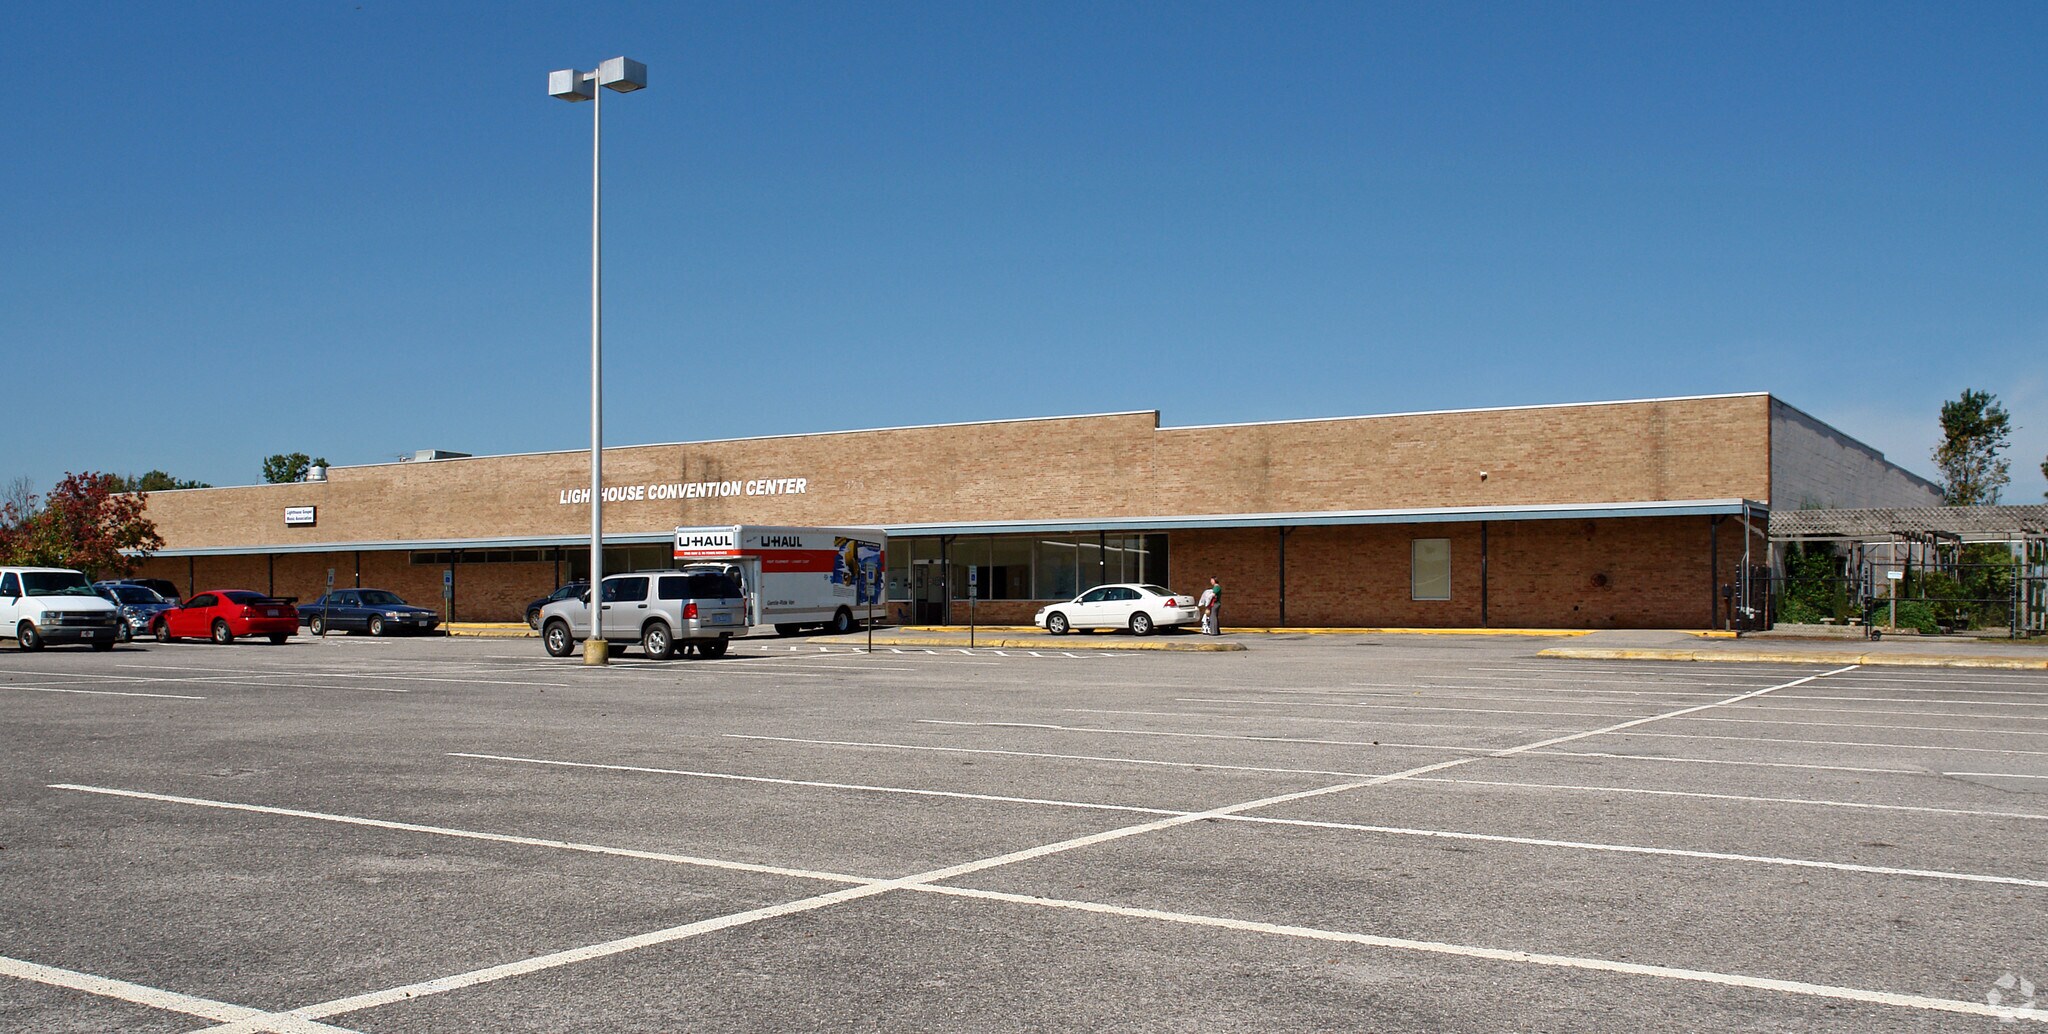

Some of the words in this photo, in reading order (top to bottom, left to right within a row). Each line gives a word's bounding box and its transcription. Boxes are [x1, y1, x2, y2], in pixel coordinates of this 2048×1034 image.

[559, 485, 645, 504] LIGHHOUSE
[647, 481, 742, 500] CONVENTION
[745, 478, 807, 495] CENTER
[678, 535, 733, 547] U-HAUL
[761, 535, 803, 547] U-HAUL
